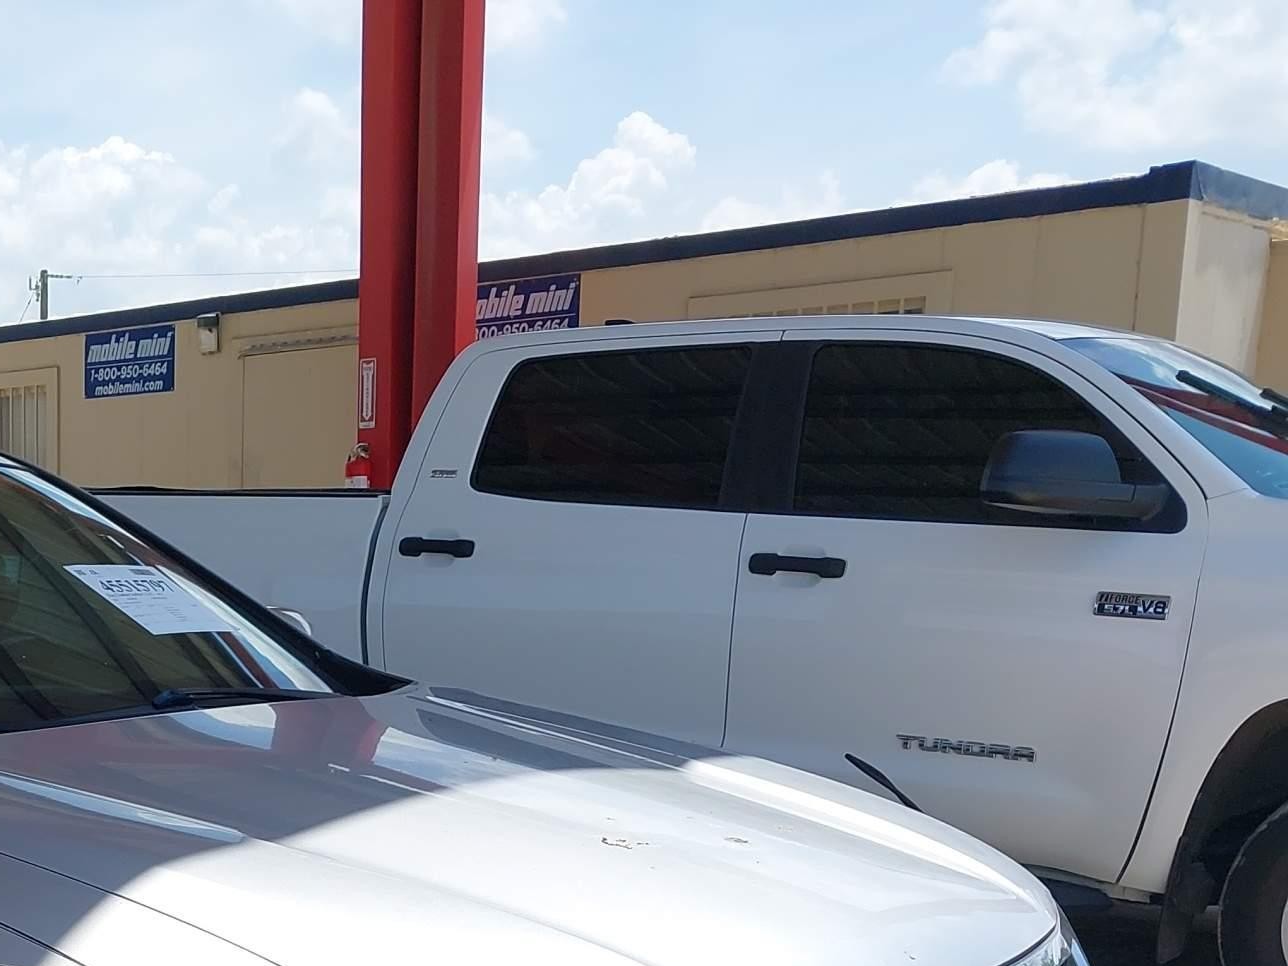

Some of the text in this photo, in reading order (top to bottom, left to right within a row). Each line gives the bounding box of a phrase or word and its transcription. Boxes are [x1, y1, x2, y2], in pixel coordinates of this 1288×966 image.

[476, 282, 575, 320] obile mini
[87, 331, 174, 363] mobile mini
[90, 361, 168, 382] 1-800-950-6464
[94, 380, 164, 396] mobilemini.com
[99, 579, 175, 593] 45515797
[1141, 599, 1167, 615] V8
[896, 733, 1037, 763] TUNDRA
